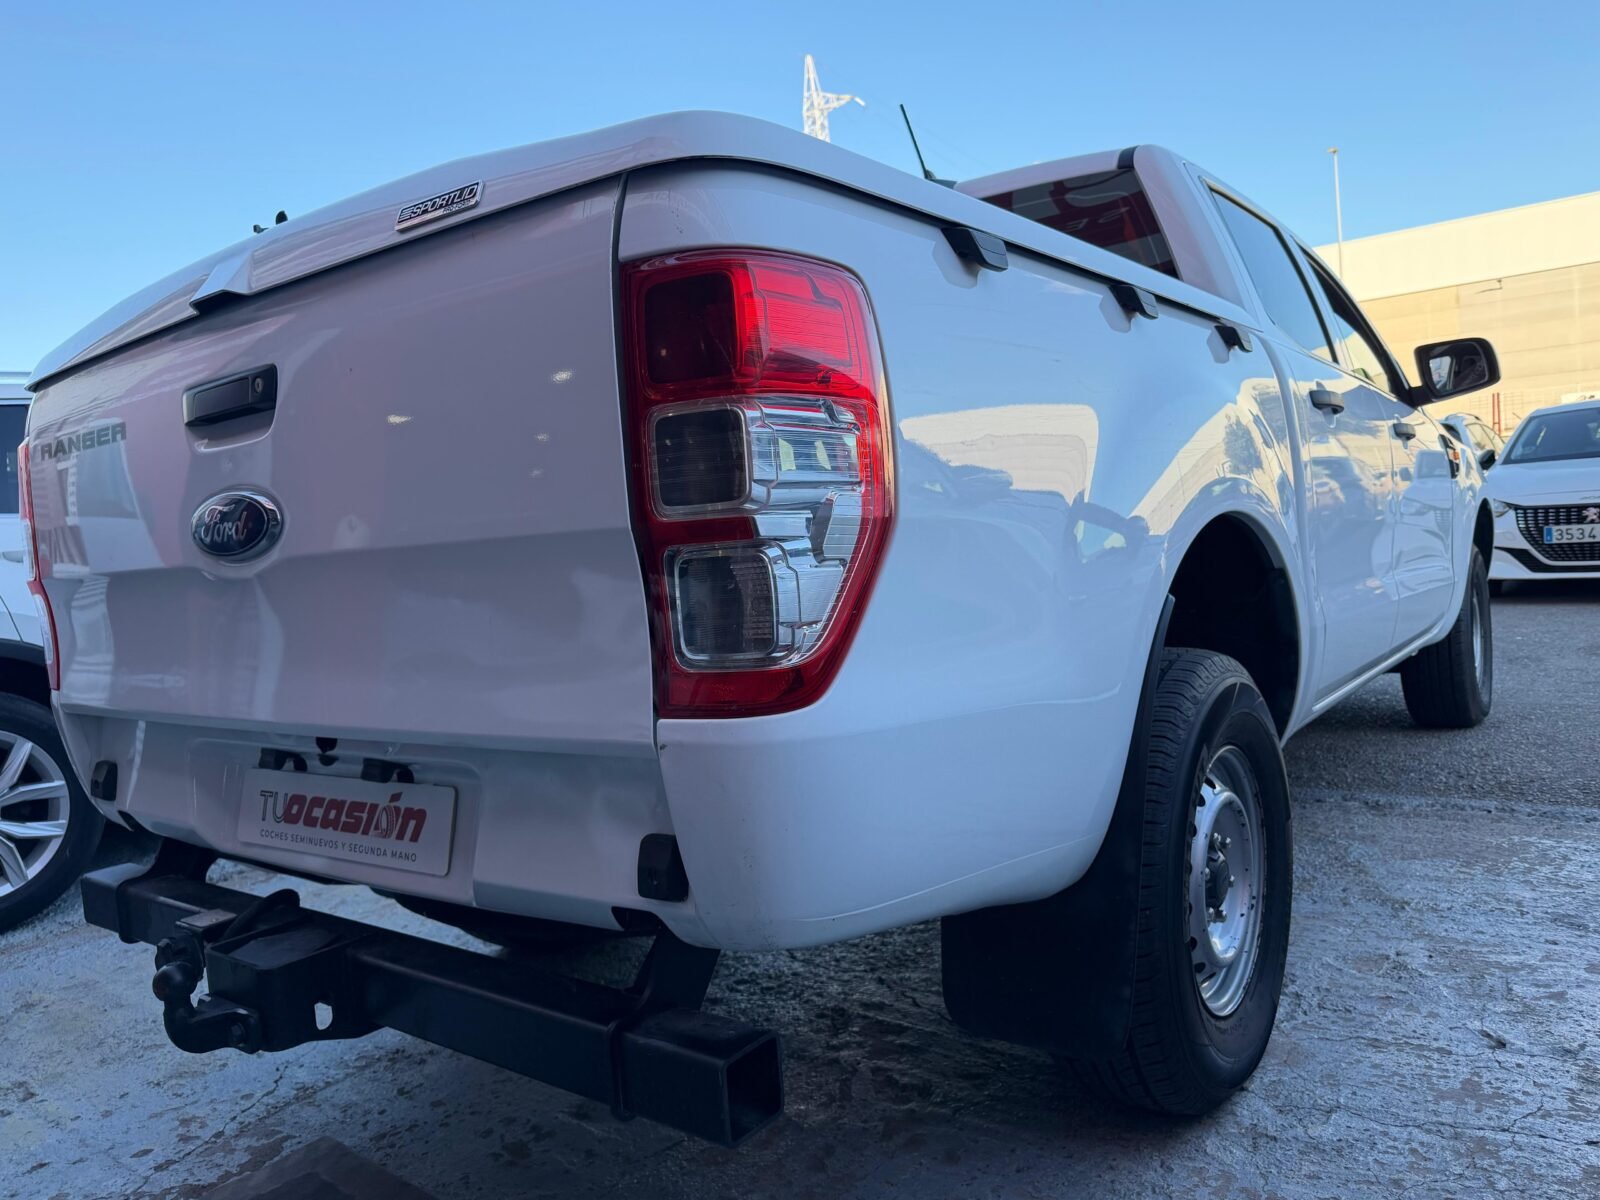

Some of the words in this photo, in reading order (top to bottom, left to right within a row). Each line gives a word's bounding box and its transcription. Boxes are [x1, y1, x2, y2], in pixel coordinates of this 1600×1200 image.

[41, 422, 126, 461] RANGER
[201, 504, 247, 544] Ford
[1555, 527, 1597, 541] 3534
[260, 829, 289, 841] COCHES
[290, 833, 339, 849] SEMINUEVOS
[341, 841, 347, 851] Y
[348, 843, 388, 857] SEGUNDA
[391, 850, 417, 862] MANO
